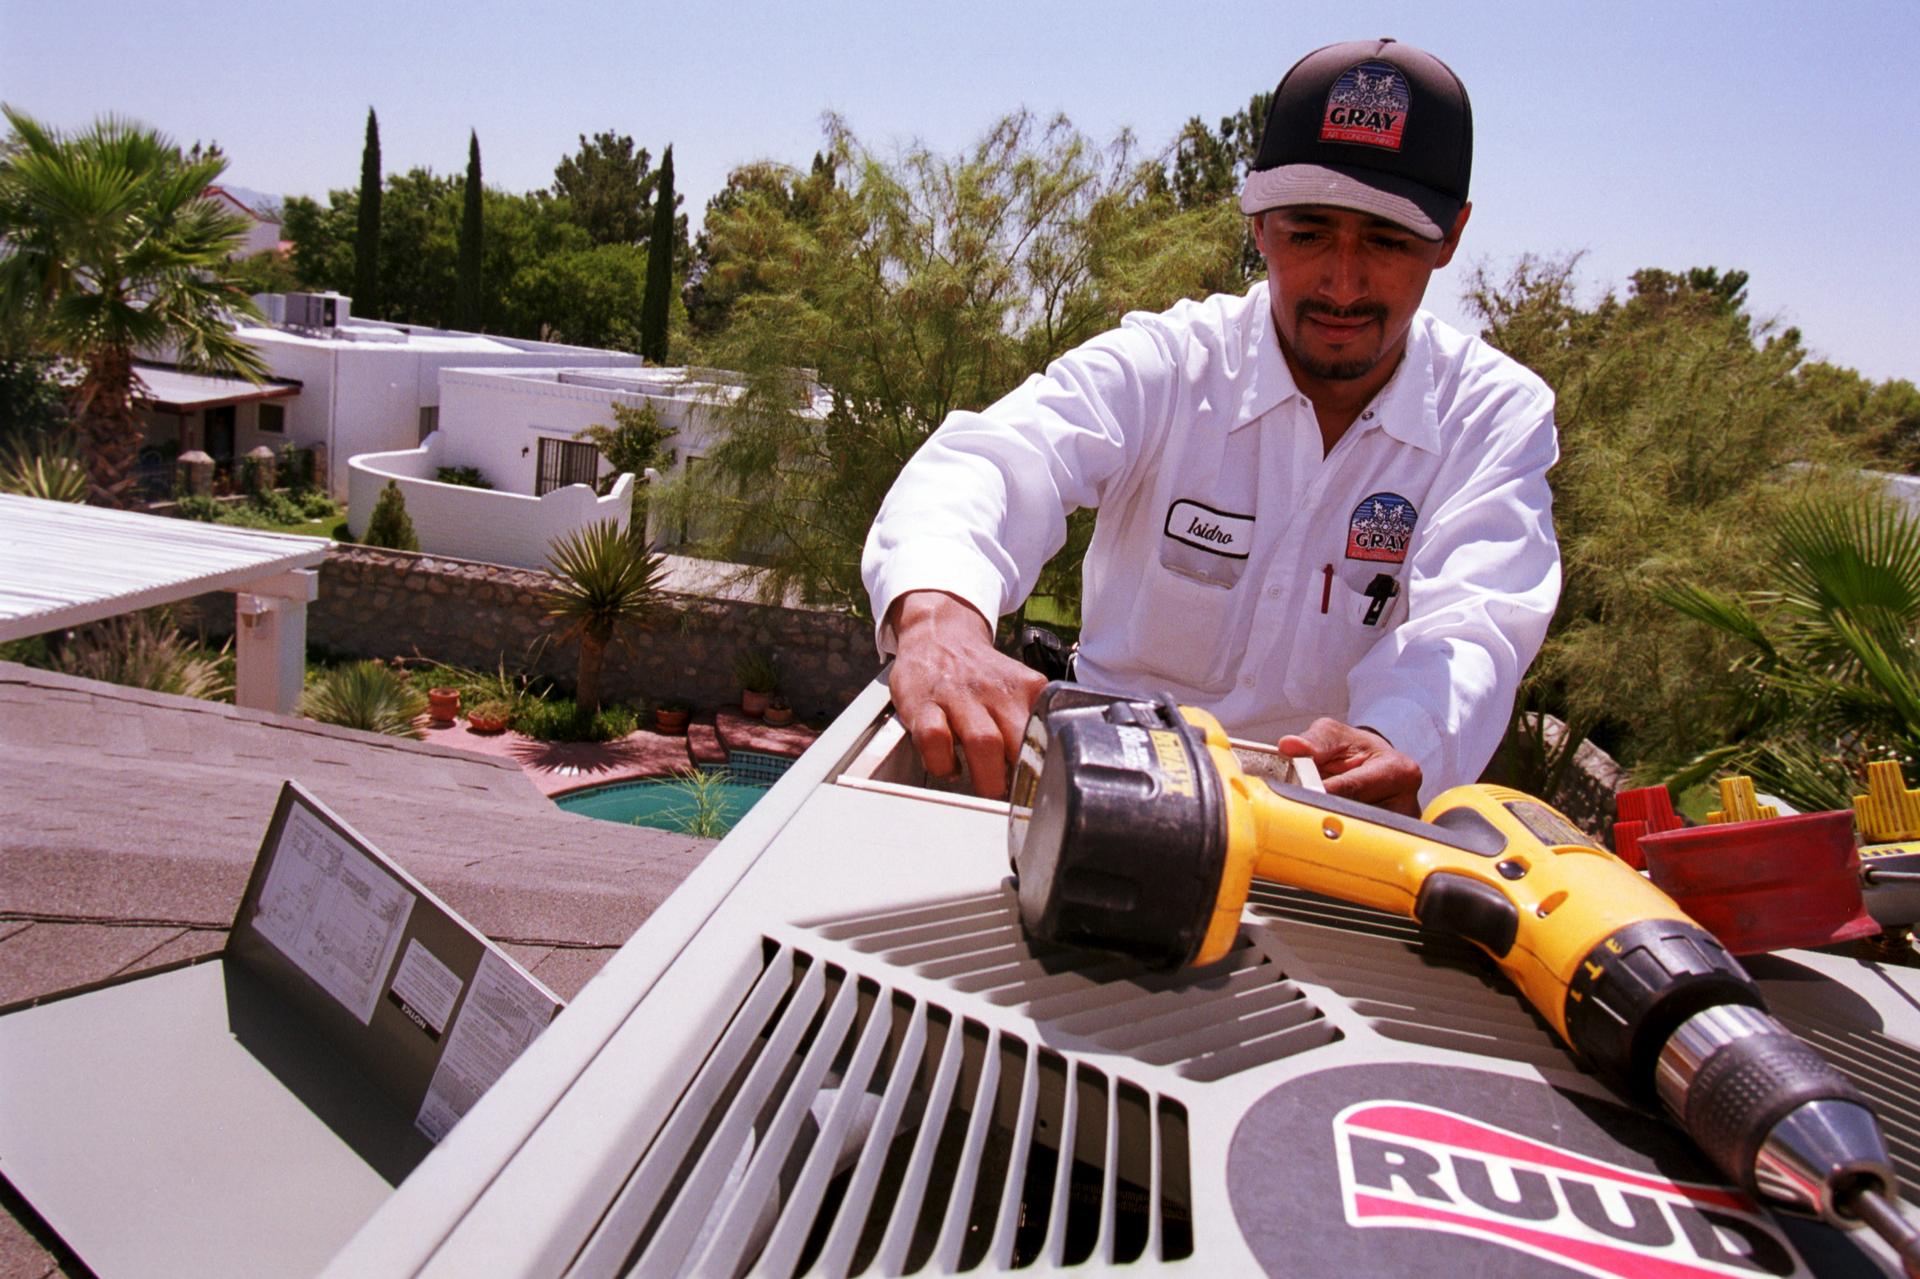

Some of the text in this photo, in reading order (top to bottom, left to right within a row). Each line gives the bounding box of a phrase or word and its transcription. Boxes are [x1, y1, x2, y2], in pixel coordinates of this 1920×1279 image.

[1329, 107, 1398, 131] GRAY
[1341, 132, 1395, 146] CONDITIONING
[1187, 517, 1234, 546] Isidro
[1355, 532, 1410, 550] GRAY
[1348, 1133, 1796, 1278] RUUD
